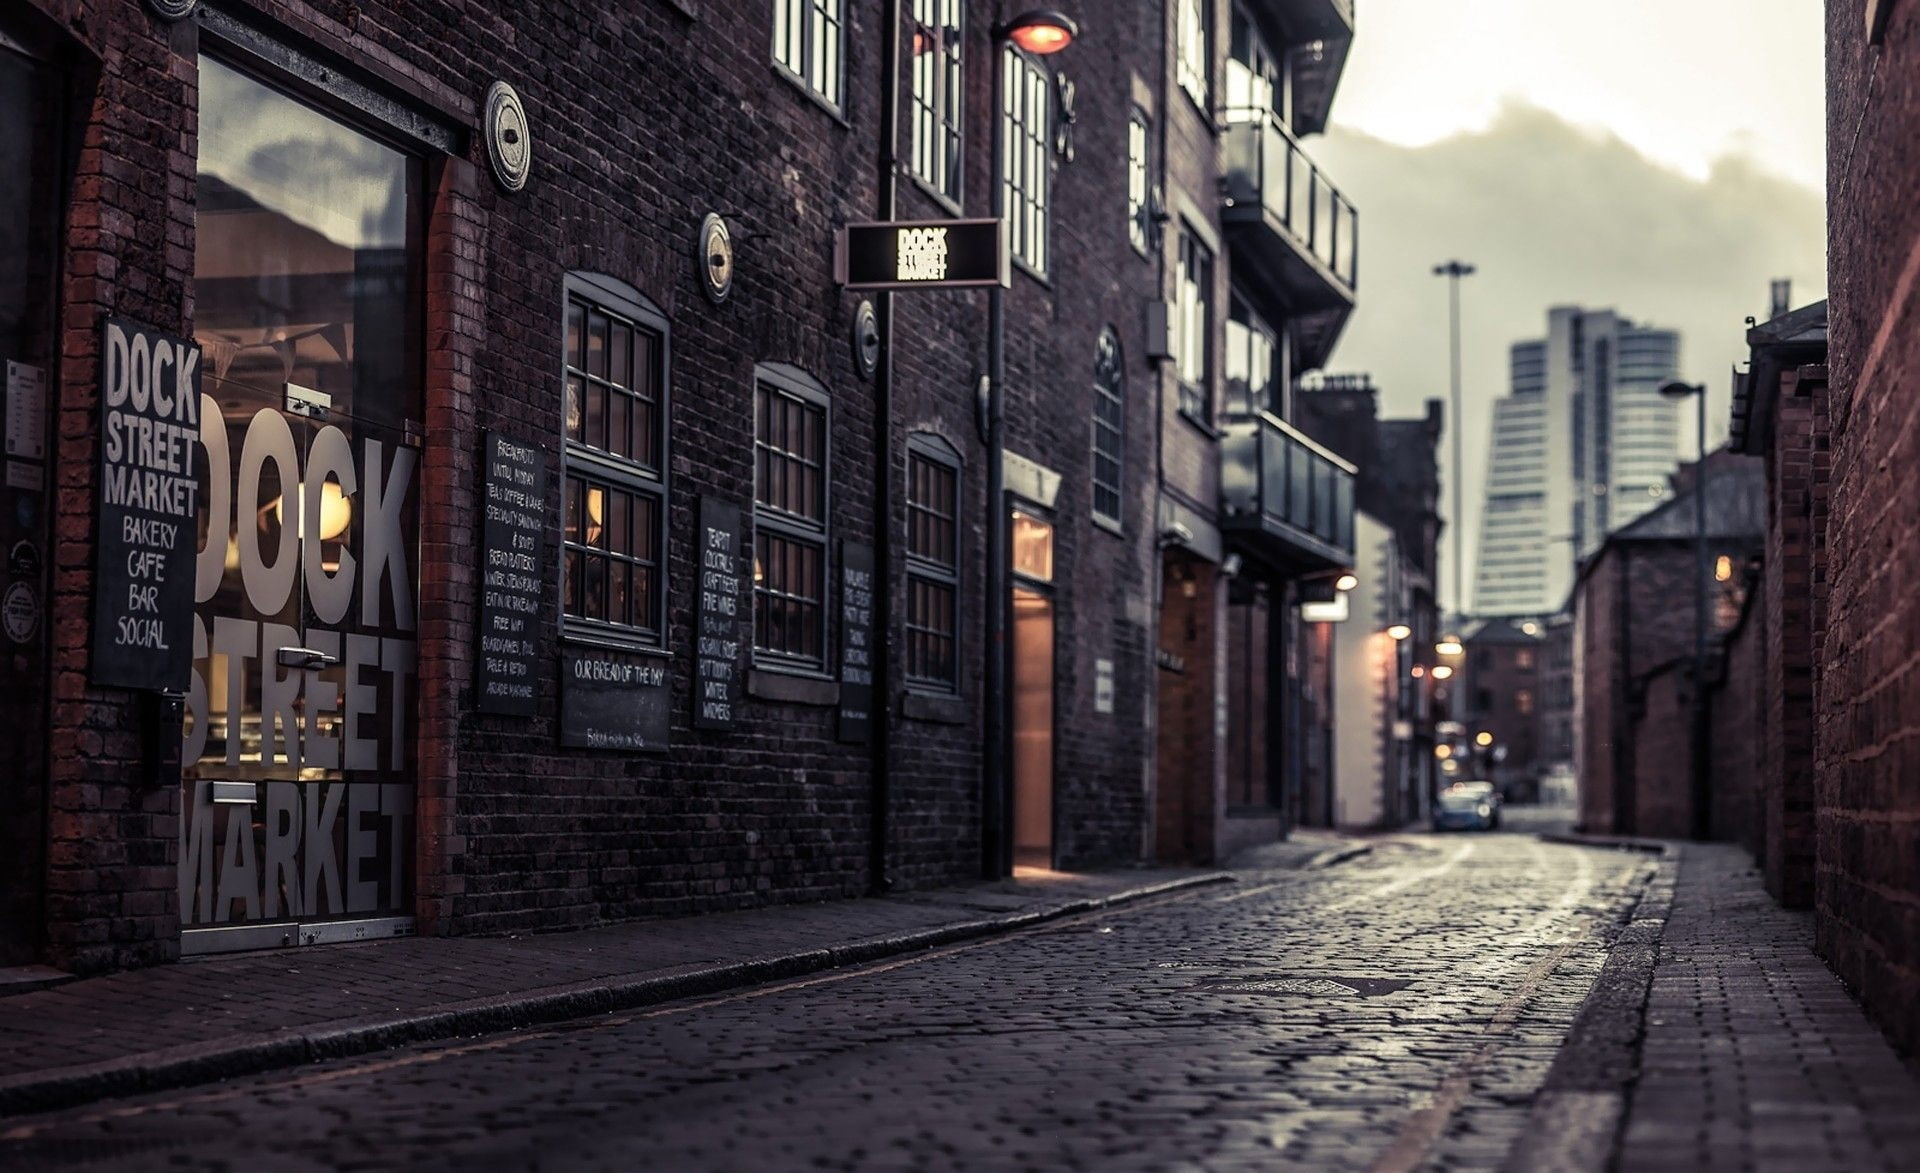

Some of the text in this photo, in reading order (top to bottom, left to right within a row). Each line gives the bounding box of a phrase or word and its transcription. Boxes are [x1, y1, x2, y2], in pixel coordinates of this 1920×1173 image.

[898, 228, 947, 251] DOCK
[107, 323, 200, 425] DOCK
[107, 410, 199, 477] STREET
[104, 463, 199, 518] MARKET
[122, 515, 178, 550] BAKERY
[127, 550, 165, 582] CAFE
[128, 584, 159, 614] BAR
[115, 616, 169, 650] SOCIAL
[574, 659, 664, 687] OUR BREAD OF THE DAY
